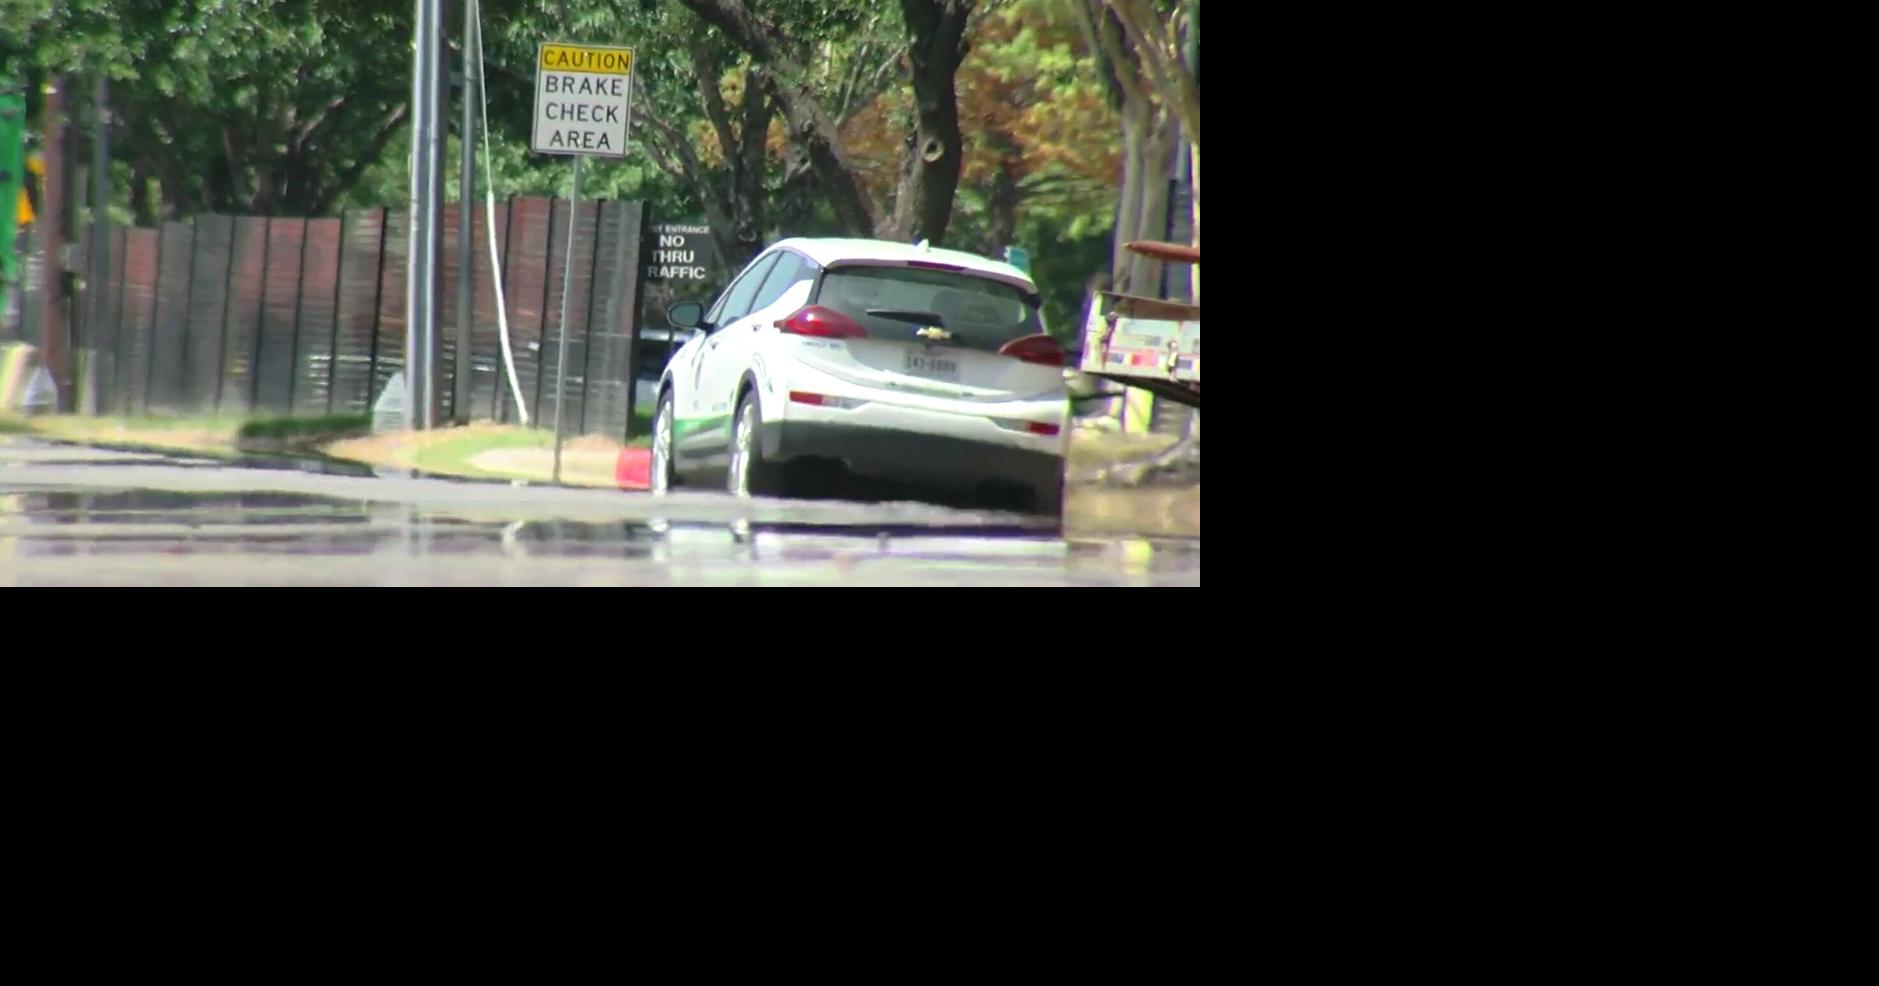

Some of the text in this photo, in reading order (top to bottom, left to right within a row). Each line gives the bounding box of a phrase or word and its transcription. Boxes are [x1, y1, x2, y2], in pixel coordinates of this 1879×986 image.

[543, 50, 630, 70] CAUTION
[545, 75, 623, 97] BRAKE
[545, 102, 619, 123] CHECK
[549, 129, 611, 150] AREA
[665, 225, 710, 234] ENTRANCE
[659, 234, 685, 247] NO
[652, 250, 694, 263] THRU
[647, 266, 706, 279] RAFFIC
